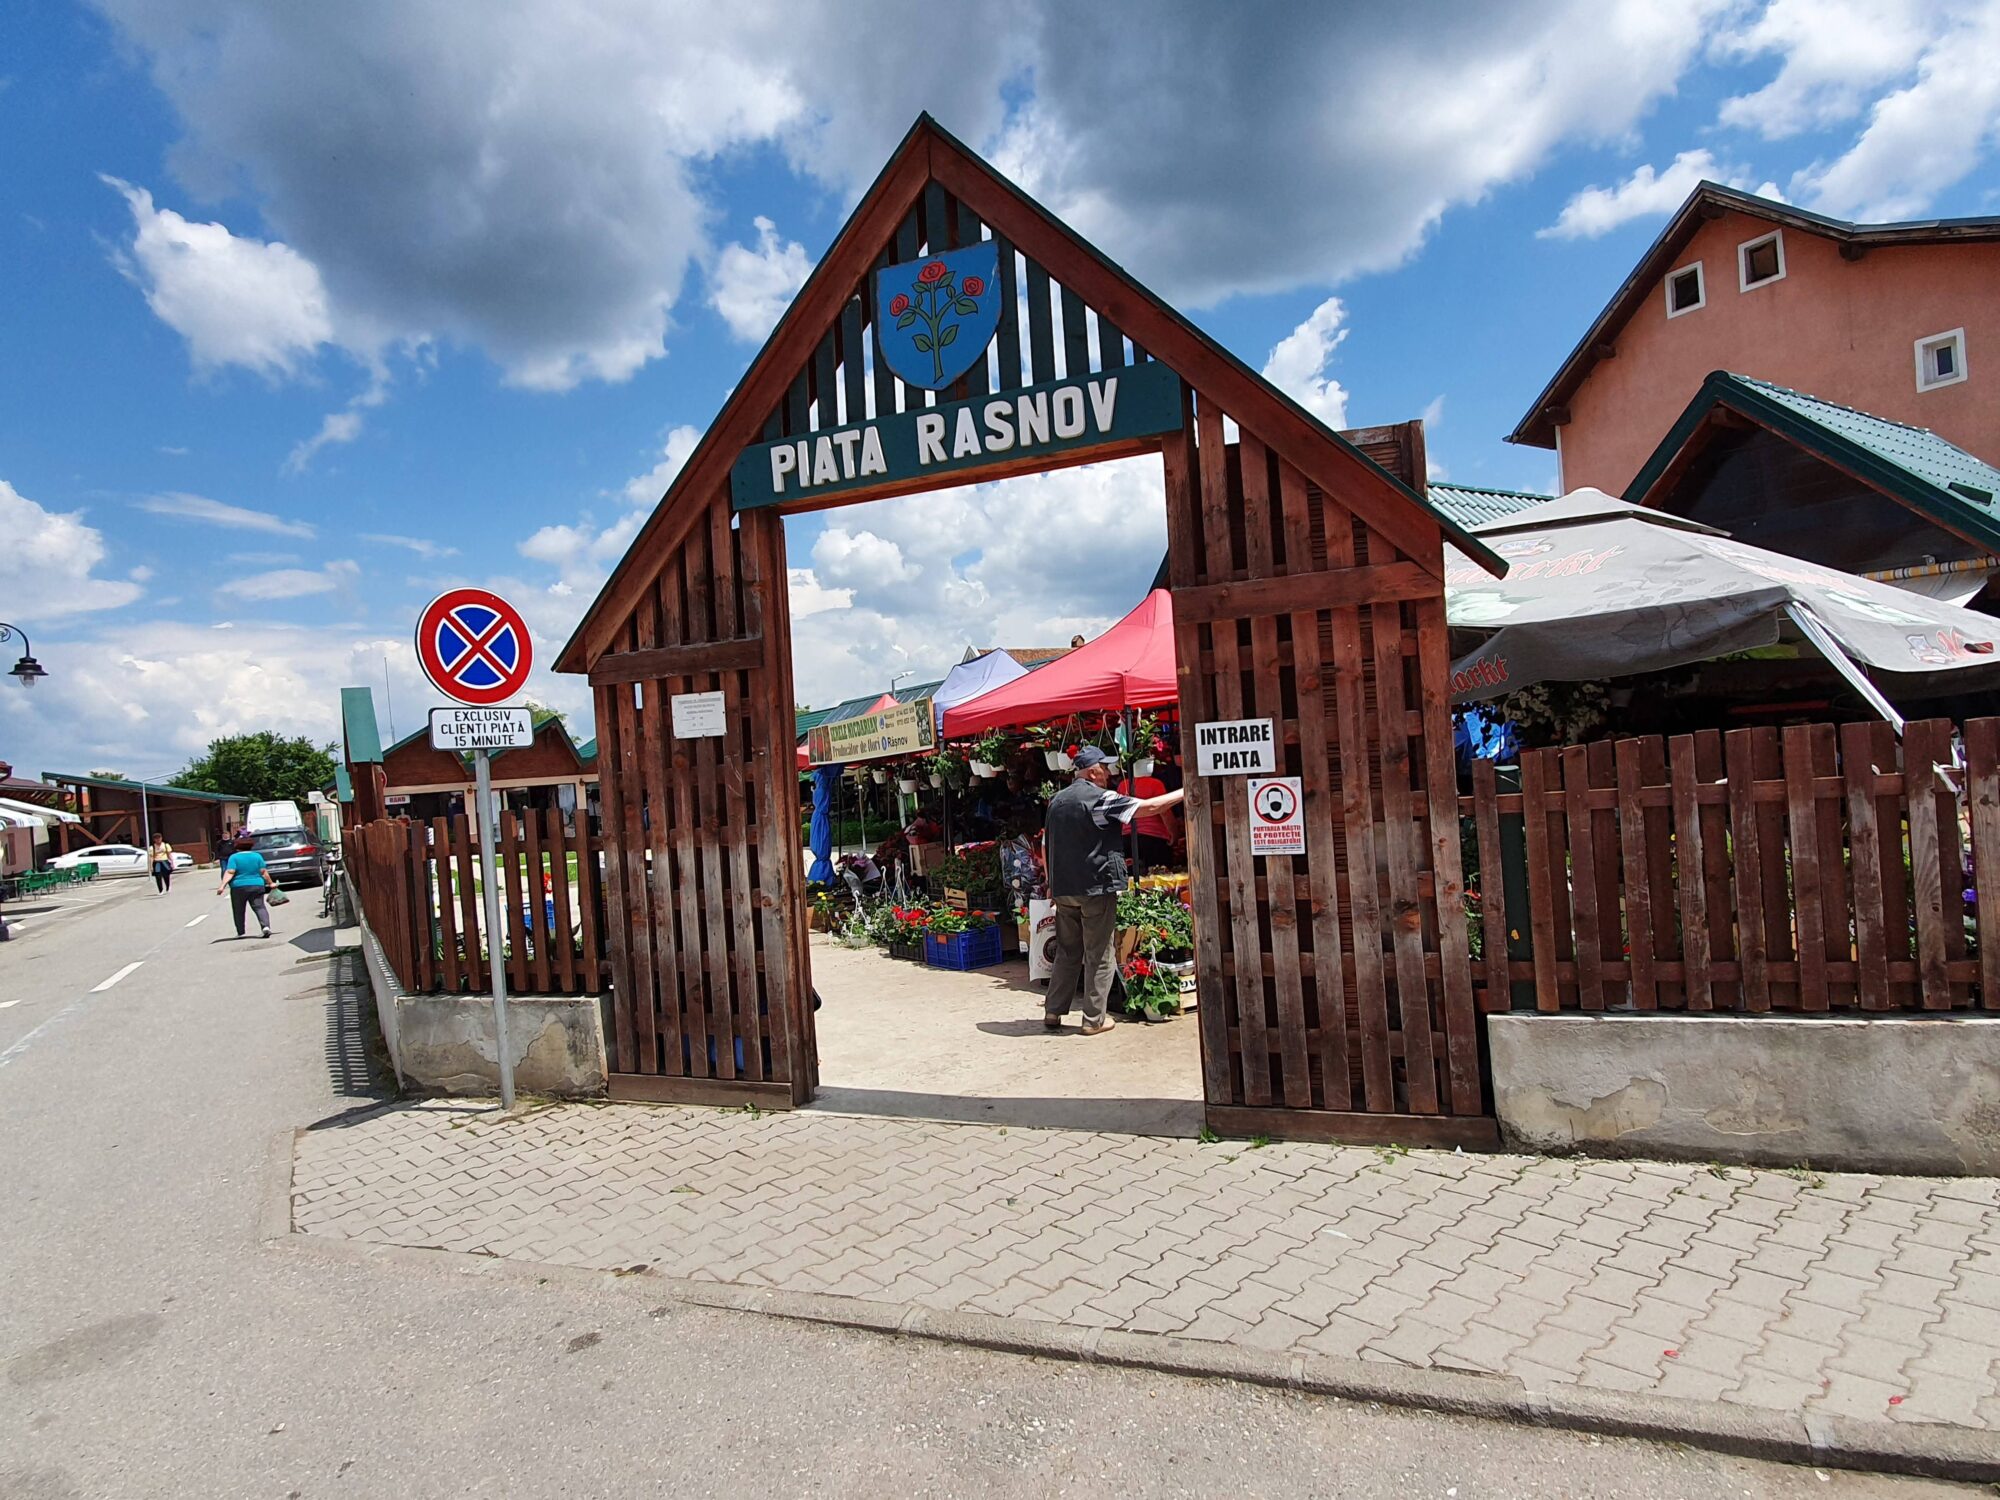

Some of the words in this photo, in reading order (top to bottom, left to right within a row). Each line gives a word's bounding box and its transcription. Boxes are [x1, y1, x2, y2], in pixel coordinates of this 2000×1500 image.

[770, 426, 888, 493] PIATA
[916, 378, 1118, 465] RASNOV
[1450, 653, 1509, 694] arkt
[454, 710, 511, 722] EXCLUSIV
[441, 723, 487, 735] CLIENTI
[1200, 724, 1270, 746] INTRARE
[454, 736, 467, 747] 15
[472, 735, 515, 746] MINUTE
[1212, 750, 1261, 770] PIATA
